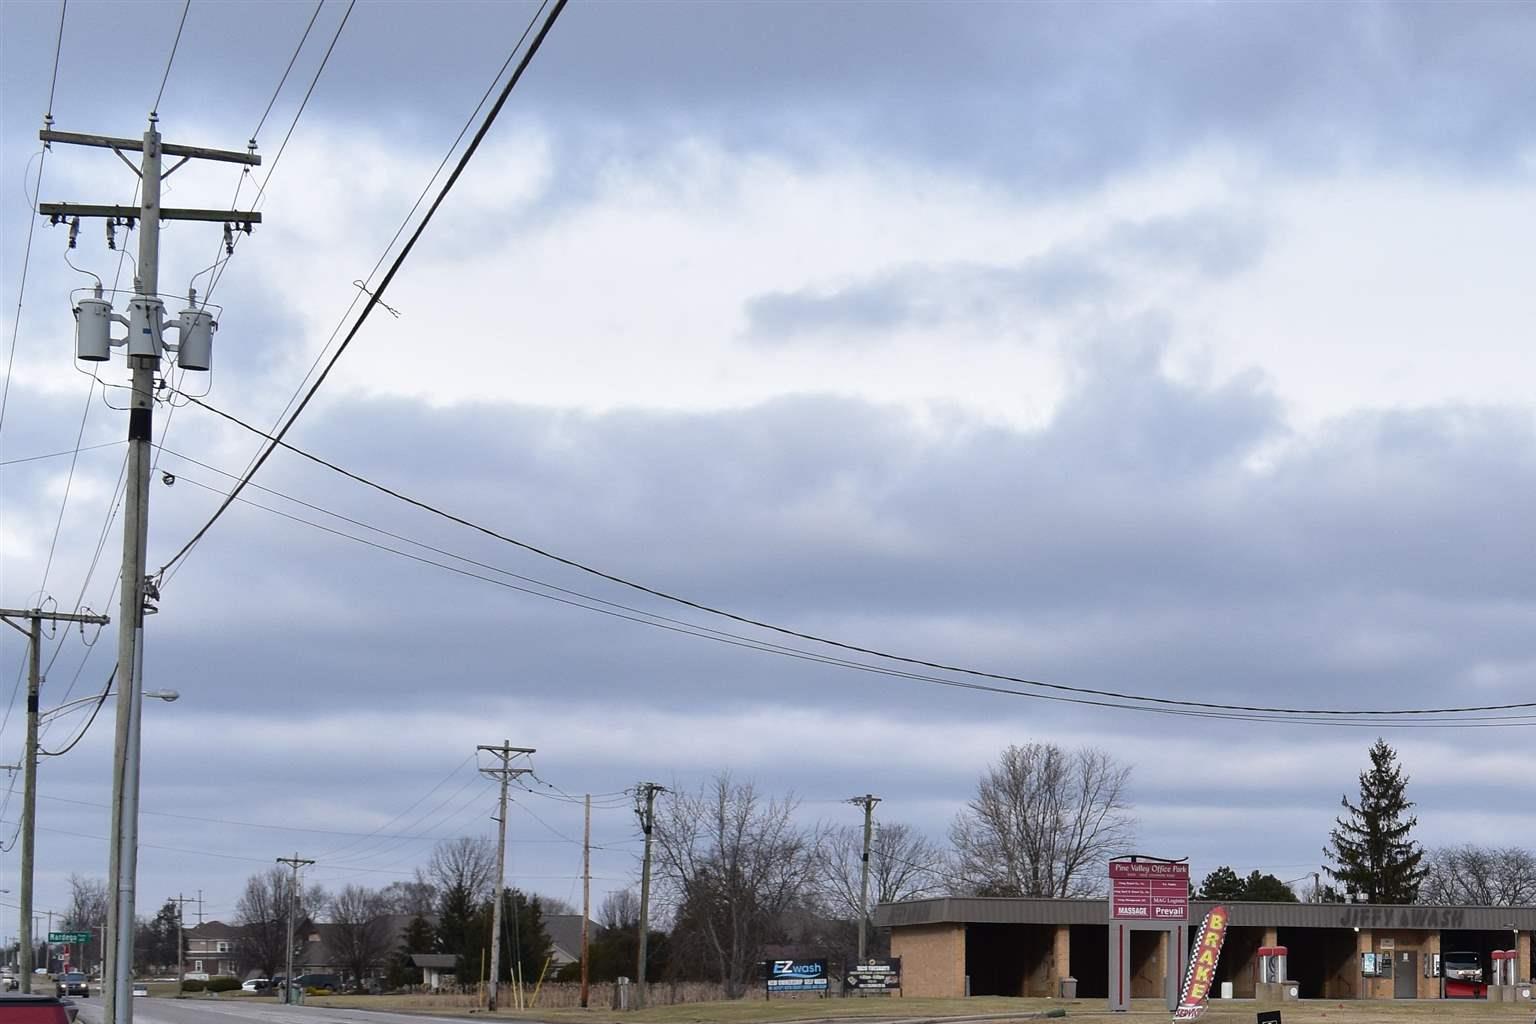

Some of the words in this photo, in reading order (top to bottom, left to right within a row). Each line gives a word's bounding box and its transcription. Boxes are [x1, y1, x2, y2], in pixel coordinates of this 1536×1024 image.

[1115, 864, 1129, 872] Pine
[1131, 864, 1149, 873] Valley
[1151, 865, 1171, 873] Office
[1172, 865, 1187, 873] Park
[1118, 907, 1147, 915] MASSAGE
[1155, 907, 1184, 915] Prevail
[1341, 909, 1394, 927] JIFFY
[1191, 914, 1223, 999] BRAKE
